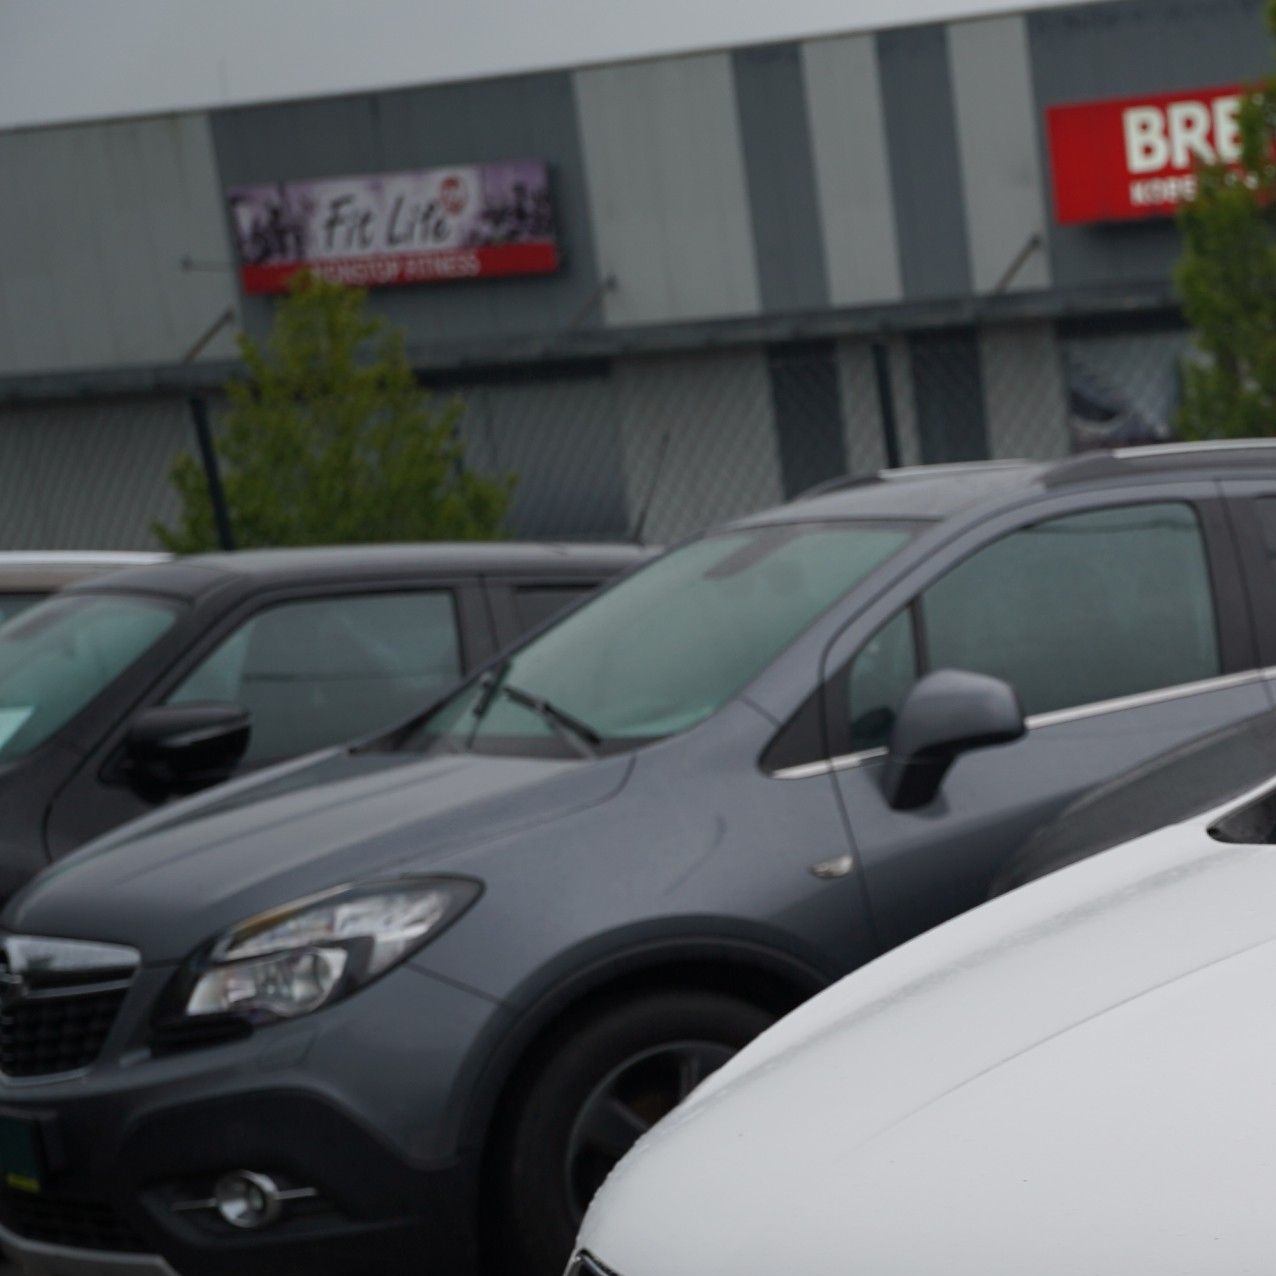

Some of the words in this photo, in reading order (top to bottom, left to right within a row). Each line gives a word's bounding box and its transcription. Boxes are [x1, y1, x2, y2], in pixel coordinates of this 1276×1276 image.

[324, 194, 375, 251] Fit
[385, 190, 451, 245] Life
[404, 250, 480, 280] FITNESS
